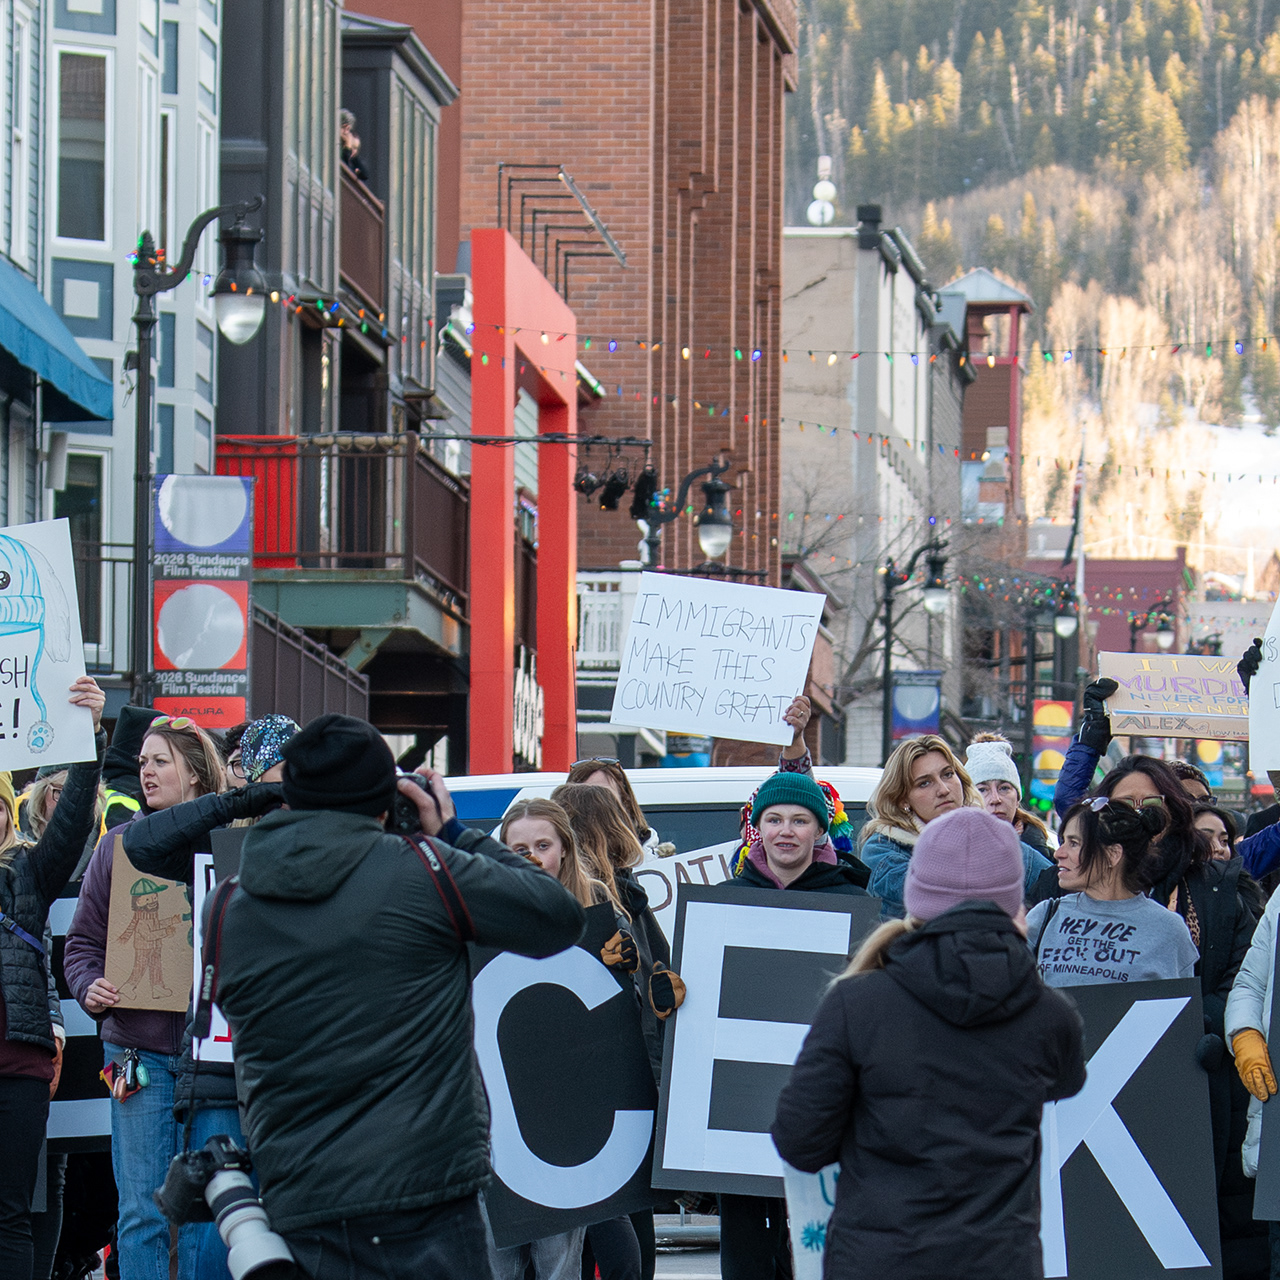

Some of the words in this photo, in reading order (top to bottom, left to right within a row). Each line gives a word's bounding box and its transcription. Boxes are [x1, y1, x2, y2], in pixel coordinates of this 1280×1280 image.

[154, 554, 185, 566] 2026
[186, 553, 249, 566] Sundance
[163, 566, 190, 577] Film
[191, 566, 240, 577] Festival
[632, 592, 816, 652] IMMIGRANTS
[627, 636, 697, 677] MAKE
[712, 648, 776, 683] THIS
[1134, 658, 1187, 673] IT
[154, 672, 183, 683] 2026
[184, 671, 247, 683] Sundance
[162, 683, 188, 694] Film
[190, 683, 238, 694] Festival
[620, 678, 708, 717] COUNTRY
[1130, 692, 1204, 704] NEVER
[181, 707, 224, 716] ACURA
[1117, 716, 1192, 730] ALEX
[1059, 916, 1099, 936] HEY
[1100, 921, 1137, 942] ICE
[1067, 936, 1090, 946] GET
[1092, 938, 1116, 950] THE
[1094, 948, 1141, 965] OUT
[1053, 963, 1129, 983] MINNEAPOLIS
